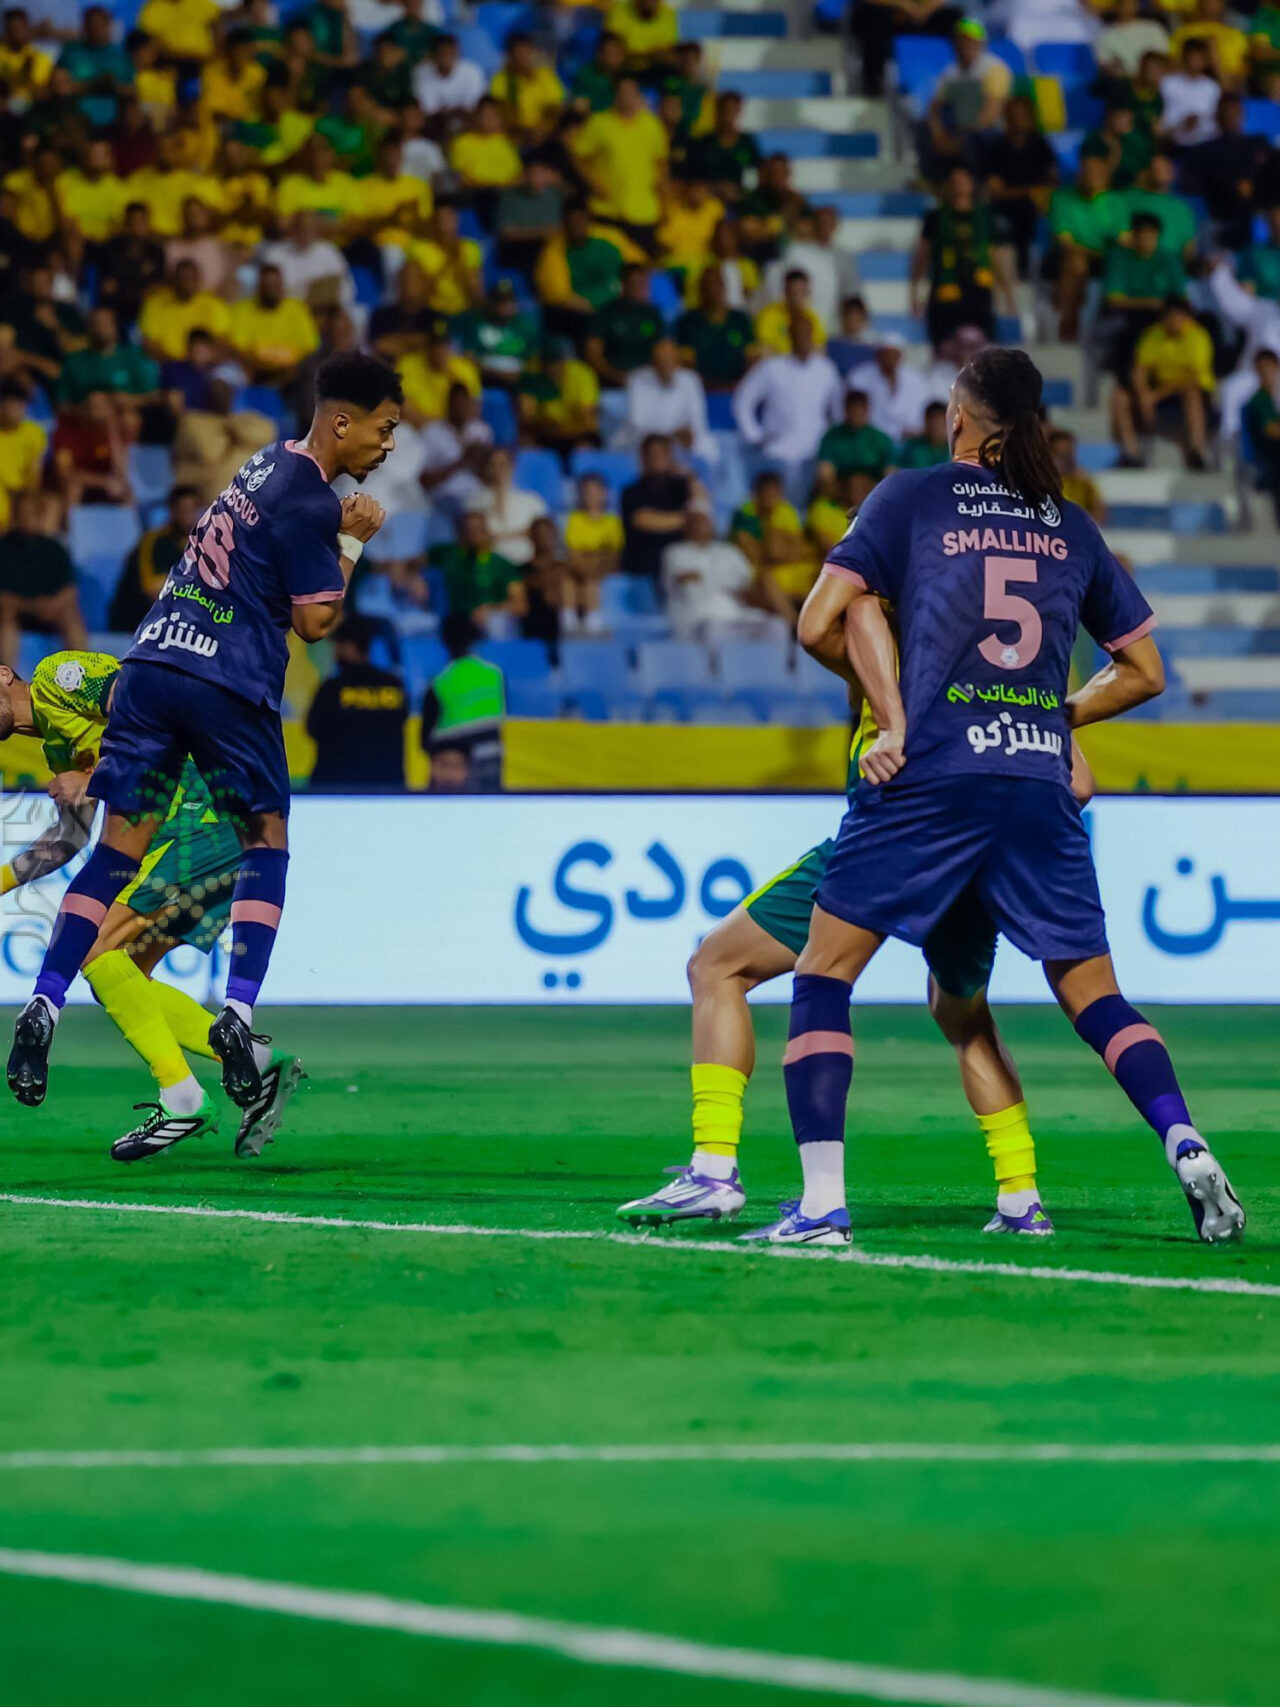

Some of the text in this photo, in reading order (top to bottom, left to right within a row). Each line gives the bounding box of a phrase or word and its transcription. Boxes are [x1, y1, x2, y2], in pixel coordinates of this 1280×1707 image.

[957, 501, 1035, 520] العقارية
[942, 528, 1069, 561] SMALLING
[977, 556, 1043, 670] 5
